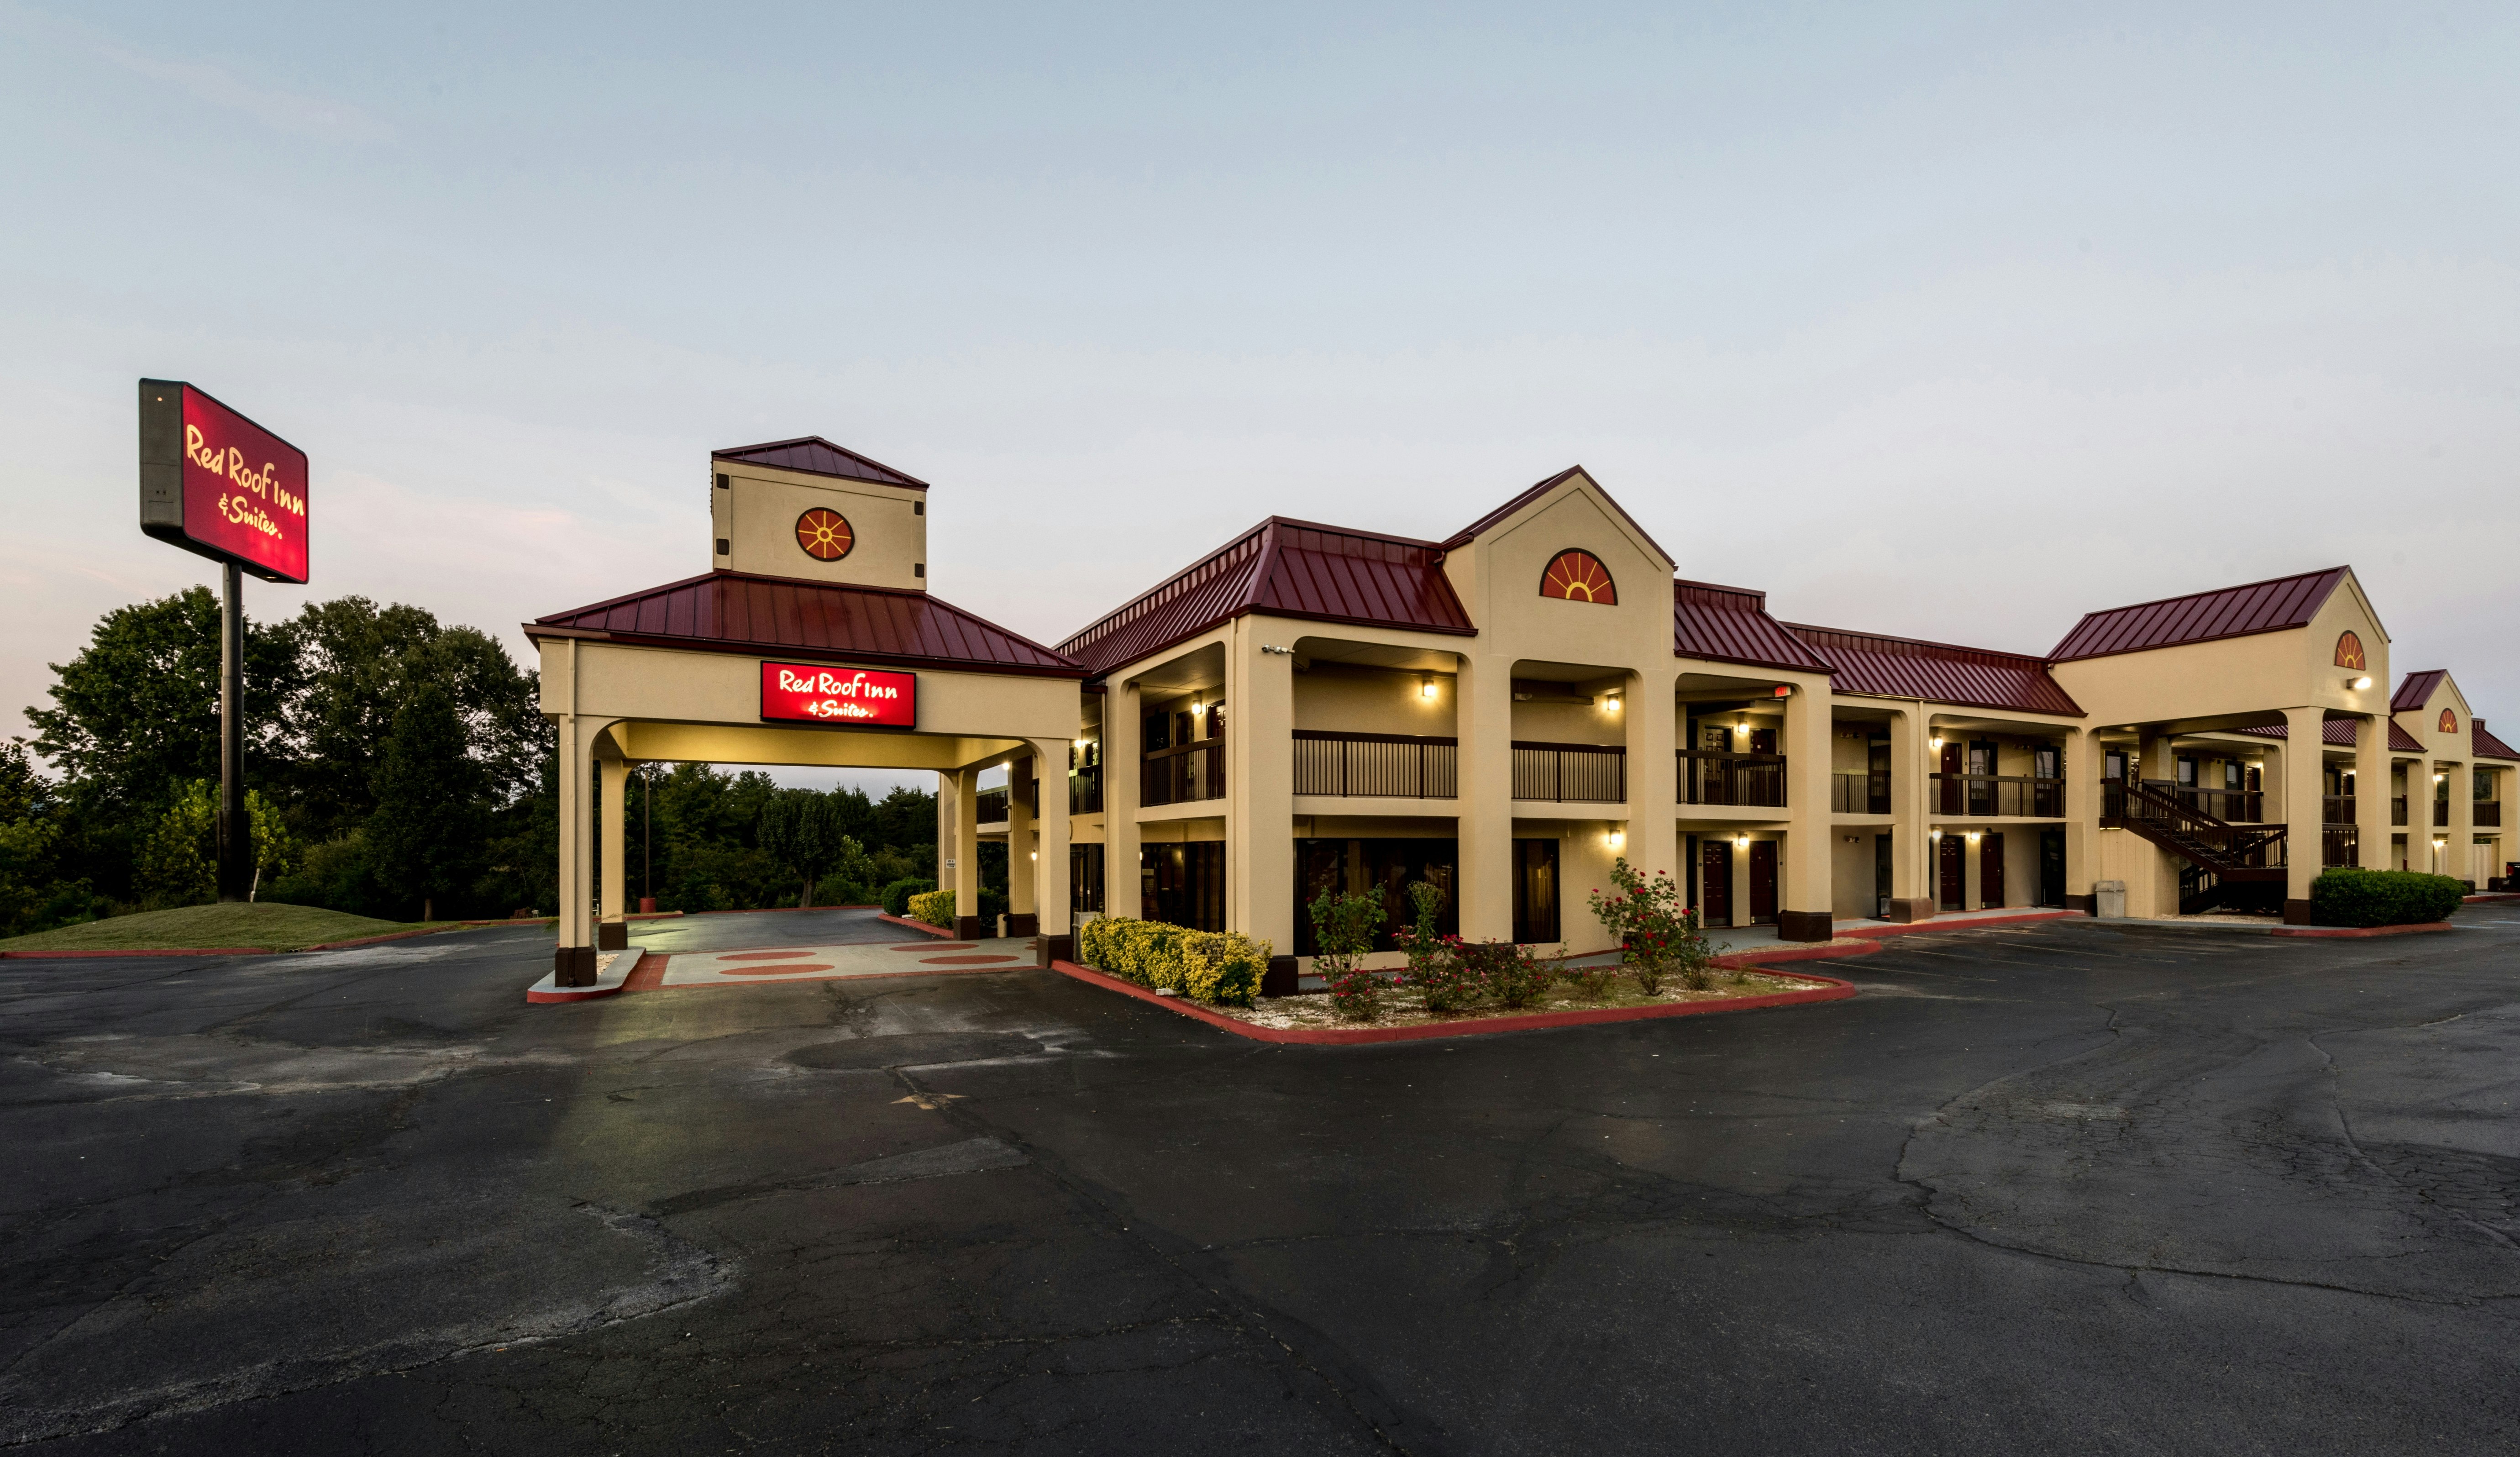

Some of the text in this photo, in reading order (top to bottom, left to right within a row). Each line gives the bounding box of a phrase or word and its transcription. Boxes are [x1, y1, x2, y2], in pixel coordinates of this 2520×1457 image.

[186, 424, 304, 516] Red Roof Inn
[779, 669, 898, 699] Red Roof Inn
